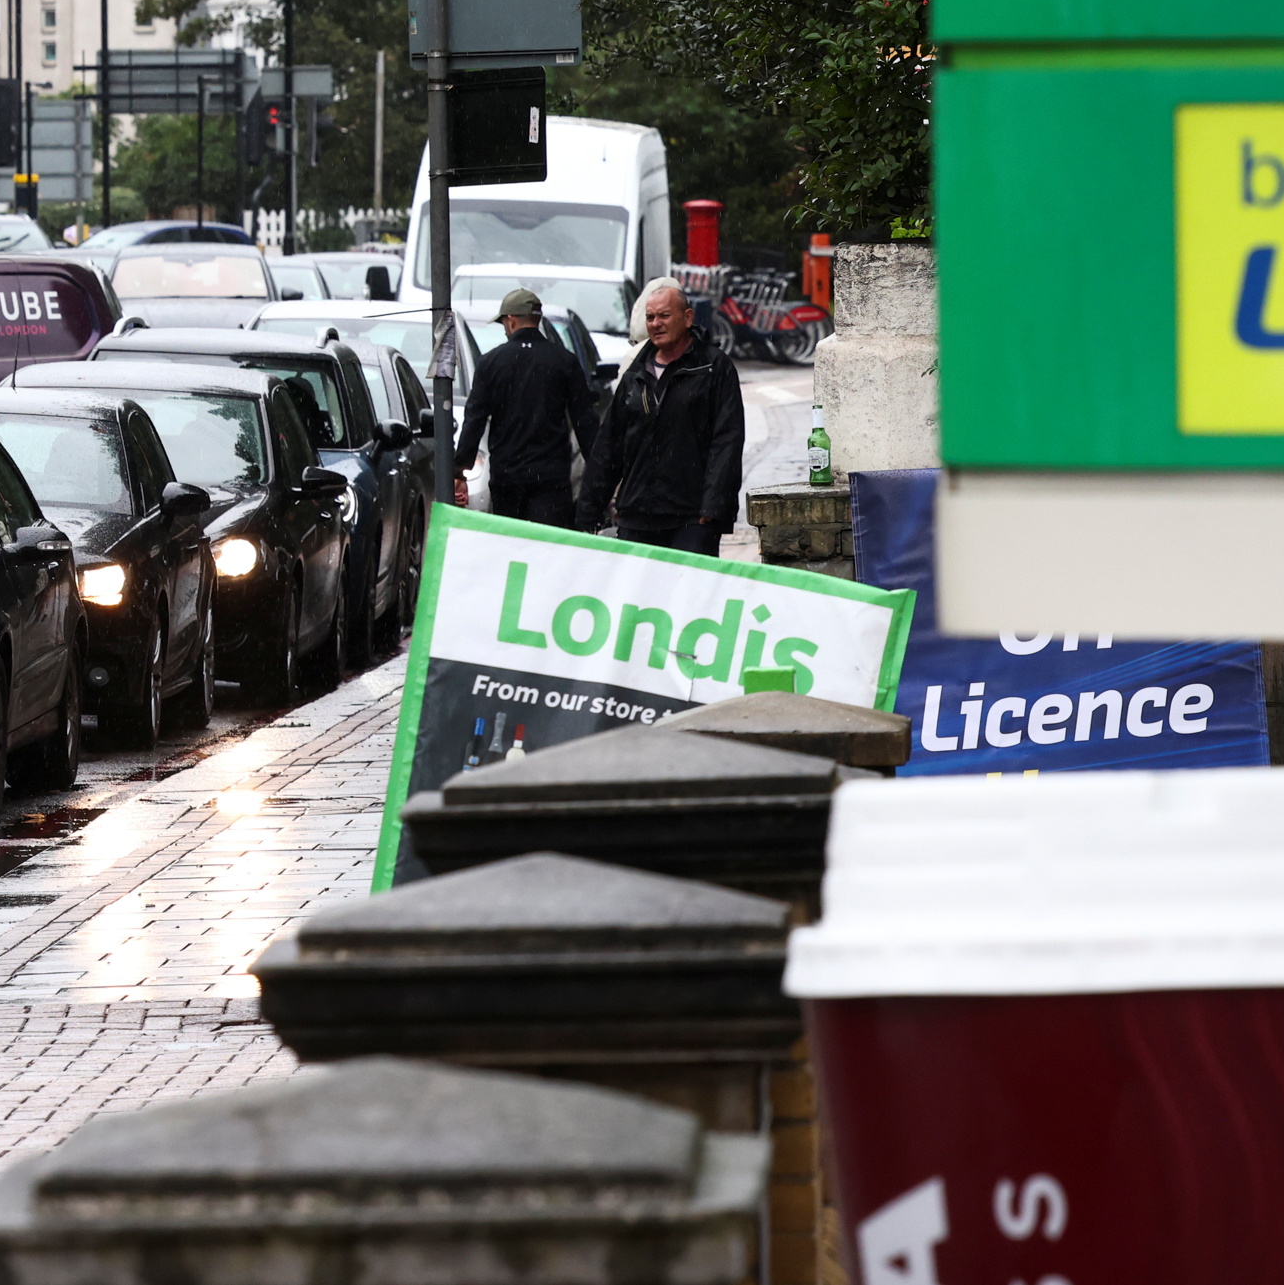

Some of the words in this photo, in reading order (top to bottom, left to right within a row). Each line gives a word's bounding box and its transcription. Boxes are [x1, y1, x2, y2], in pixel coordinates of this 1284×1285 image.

[497, 560, 819, 695] Londis
[471, 674, 540, 705] From
[544, 690, 589, 712] our
[589, 696, 657, 725] store
[920, 681, 1215, 753] Licence
